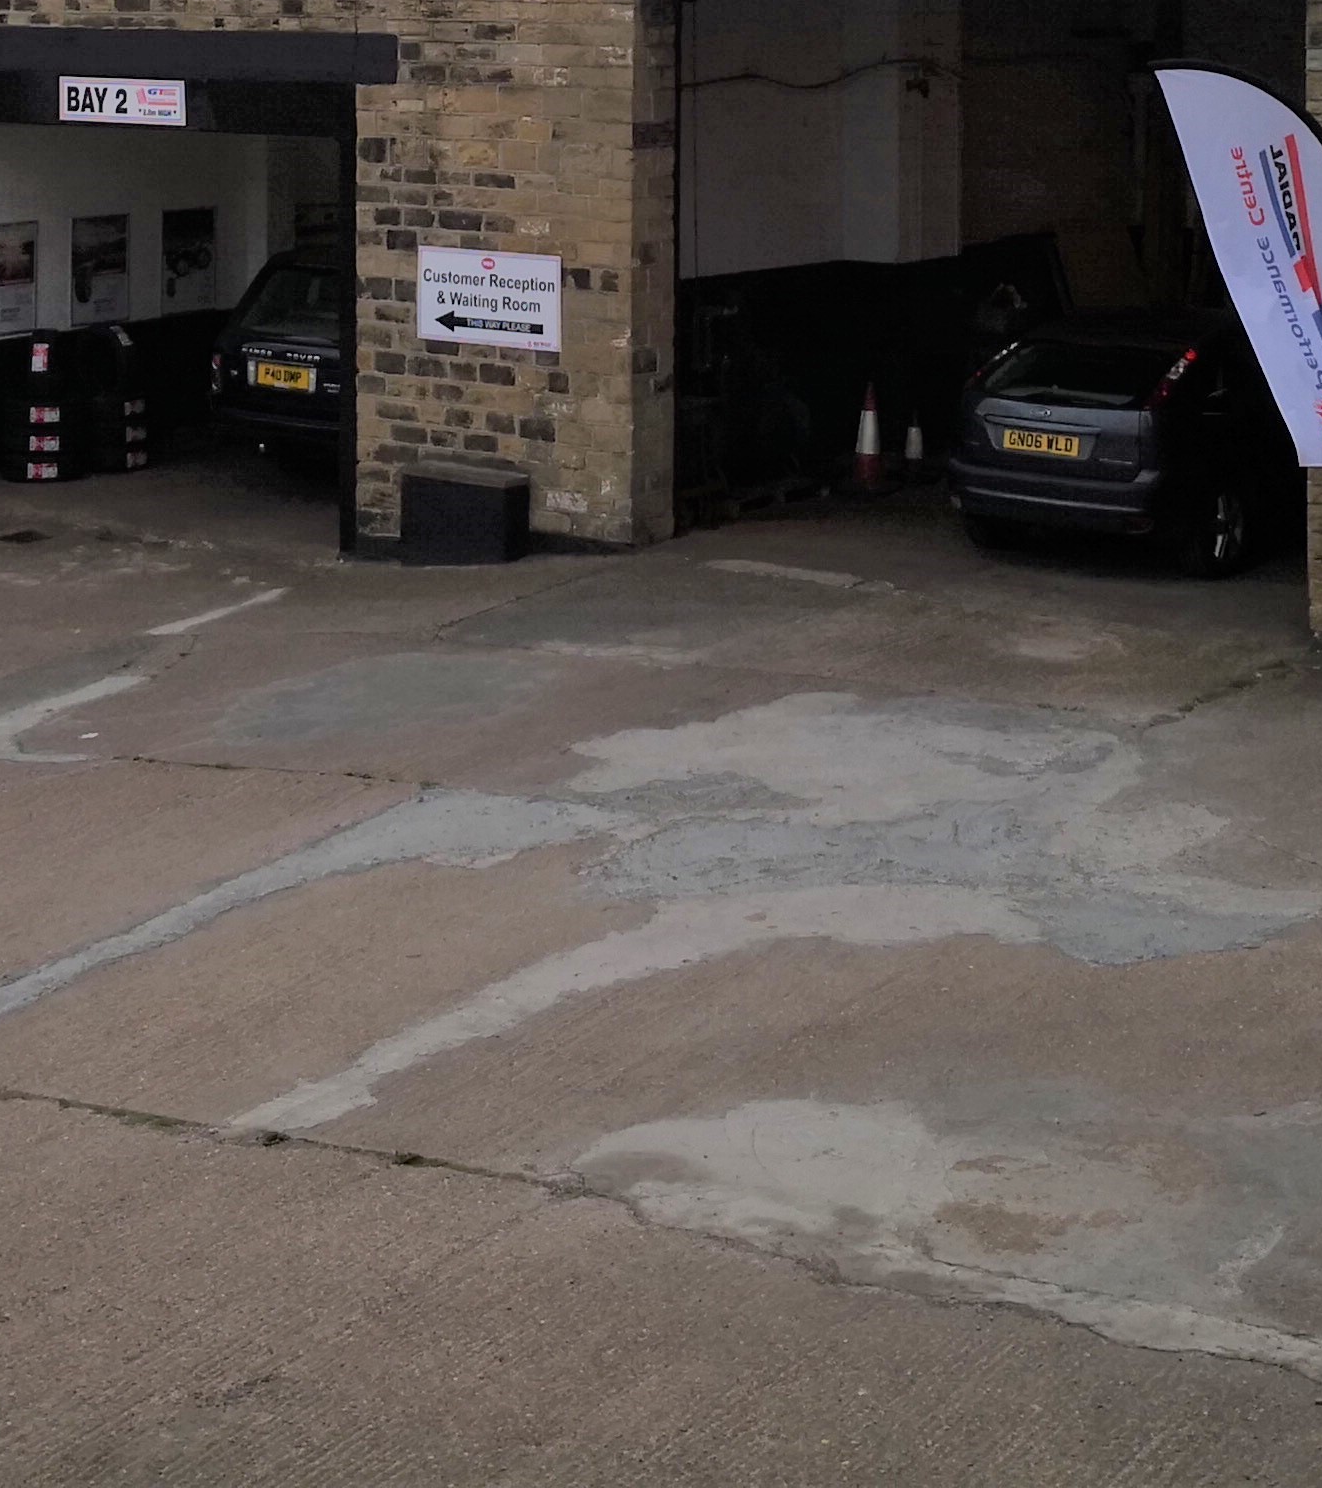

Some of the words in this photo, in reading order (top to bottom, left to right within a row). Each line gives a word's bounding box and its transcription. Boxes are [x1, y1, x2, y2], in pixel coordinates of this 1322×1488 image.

[67, 86, 108, 112] BAY
[115, 88, 128, 114] 2
[423, 269, 485, 286] Customer
[489, 274, 555, 293] Reception
[437, 291, 446, 304] &
[450, 292, 498, 312] Waiting
[502, 296, 541, 313] Room
[466, 319, 484, 328] THIS
[485, 320, 501, 329] WAY
[502, 322, 532, 333] PLEASE
[1009, 432, 1043, 449] GN06
[1047, 434, 1073, 452] WLD
